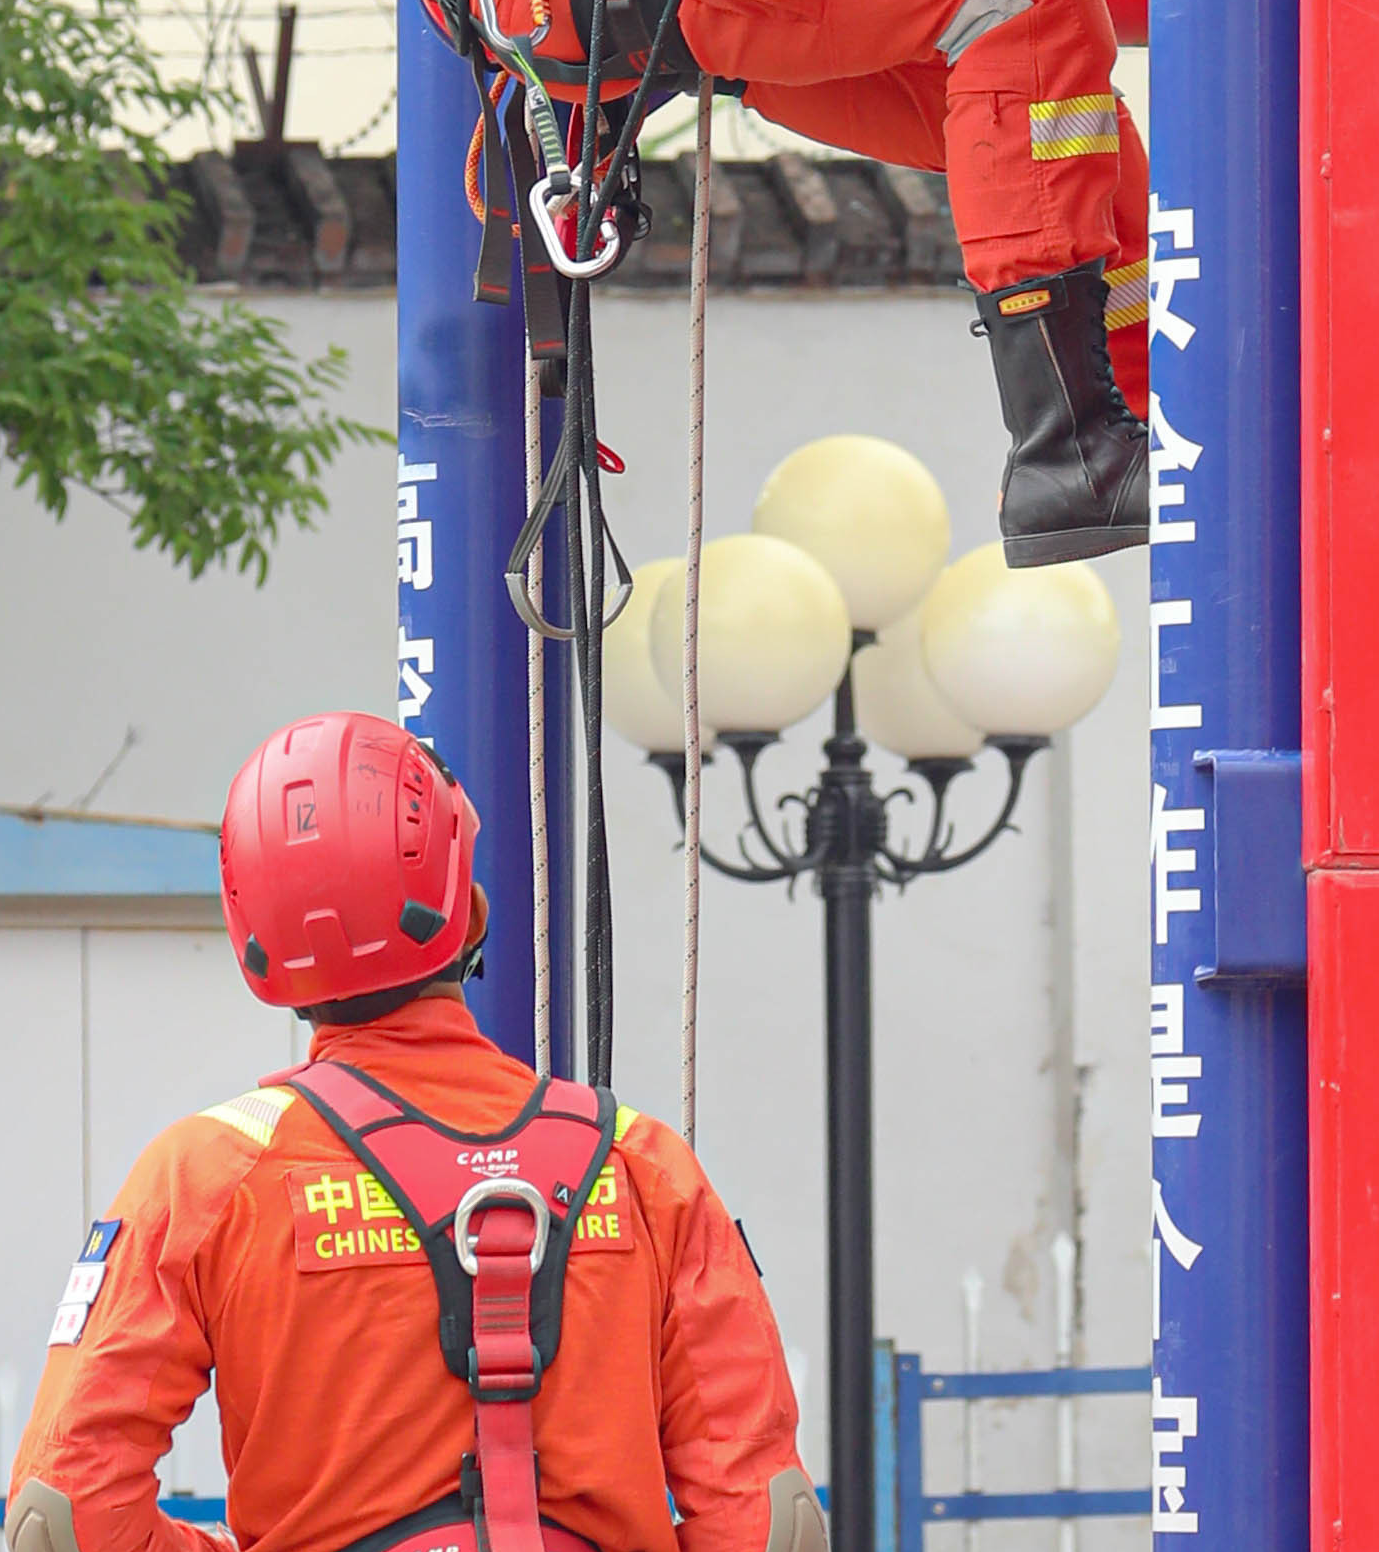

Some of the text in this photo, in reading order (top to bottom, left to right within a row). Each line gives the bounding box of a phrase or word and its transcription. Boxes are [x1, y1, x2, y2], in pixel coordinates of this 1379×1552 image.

[456, 1149, 518, 1165] CAMP
[315, 1213, 621, 1259] CHINES IRE
